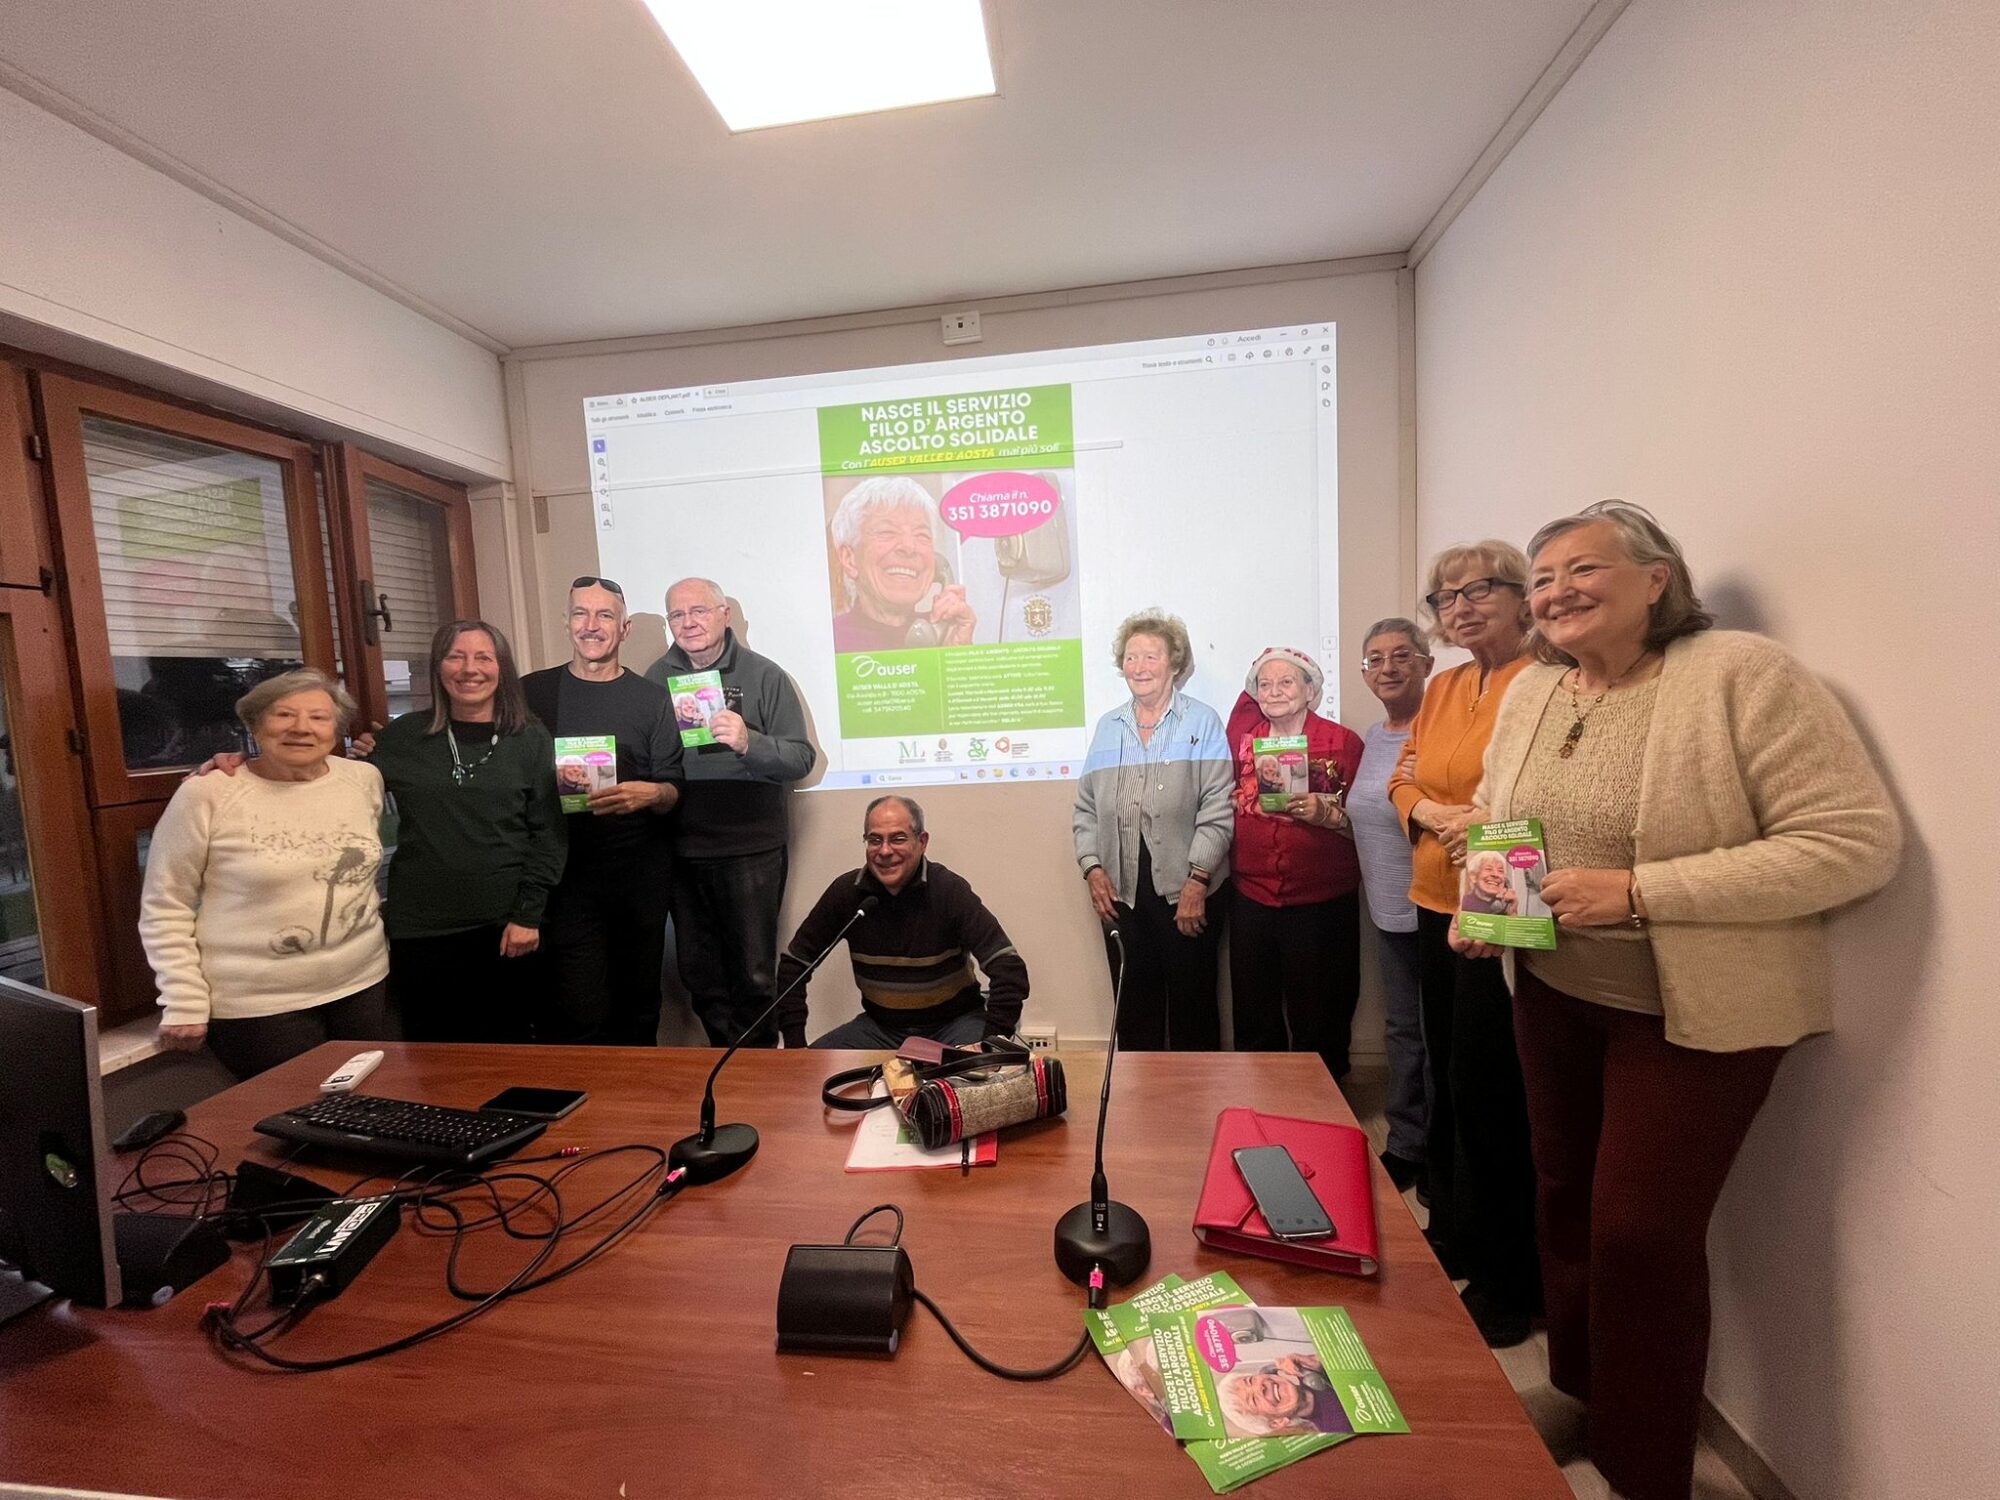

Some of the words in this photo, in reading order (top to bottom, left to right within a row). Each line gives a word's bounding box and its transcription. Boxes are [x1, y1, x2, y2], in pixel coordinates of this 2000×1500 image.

[1237, 334, 1262, 343] Accedi
[861, 402, 923, 422] NASCE
[928, 401, 943, 416] IL
[946, 392, 1032, 414] SERVIZIO
[869, 420, 908, 438] FILO
[935, 410, 1026, 432] ARGENTO
[859, 434, 945, 456] ASCOLTO
[950, 425, 1039, 448] SOLIDALE
[841, 460, 862, 471] Con
[969, 491, 1010, 504] Chiama
[948, 506, 975, 522] 351
[980, 500, 1052, 520] 3871090
[877, 663, 918, 676] auser
[968, 749, 990, 759] CSV
[1172, 1277, 1213, 1296] SERVIZIO
[1154, 1328, 1171, 1370] SERVIZIO
[1164, 1331, 1182, 1375] ARGENTO
[1171, 1325, 1190, 1368] SOLIDALE
[1164, 1371, 1173, 1379] IL
[1166, 1380, 1182, 1414] NASCE
[1178, 1388, 1191, 1410] FILO
[1182, 1369, 1204, 1417] ASCOLTO
